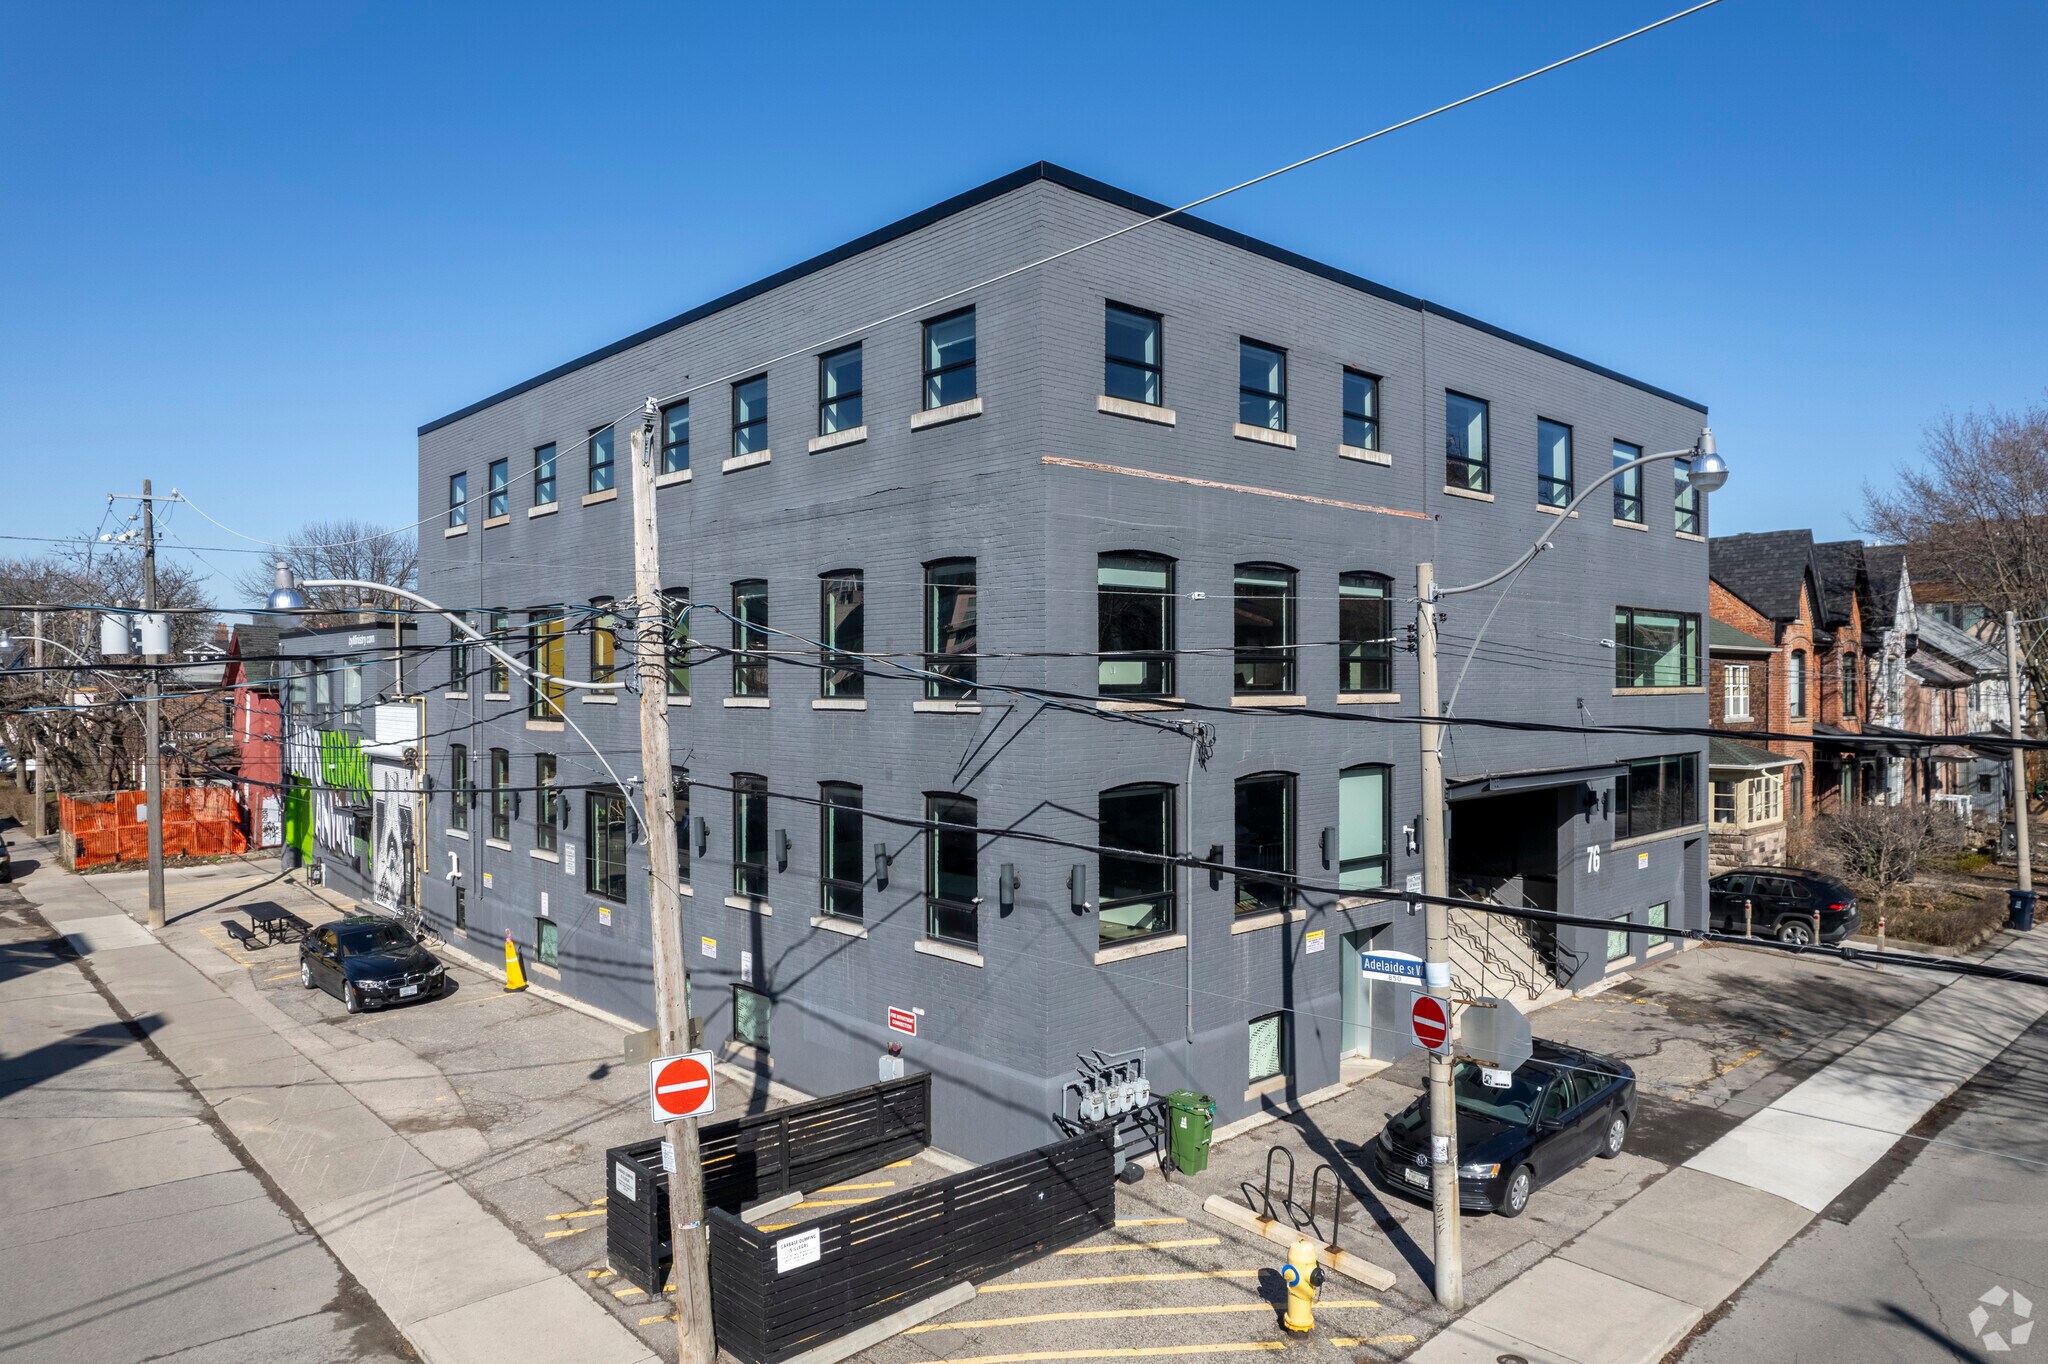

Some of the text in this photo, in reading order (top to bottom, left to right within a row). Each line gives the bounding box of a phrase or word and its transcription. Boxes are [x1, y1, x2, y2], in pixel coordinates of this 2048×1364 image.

[1587, 844, 1600, 873] 76
[1364, 958, 1404, 974] Adelaide
[1407, 966, 1415, 976] St
